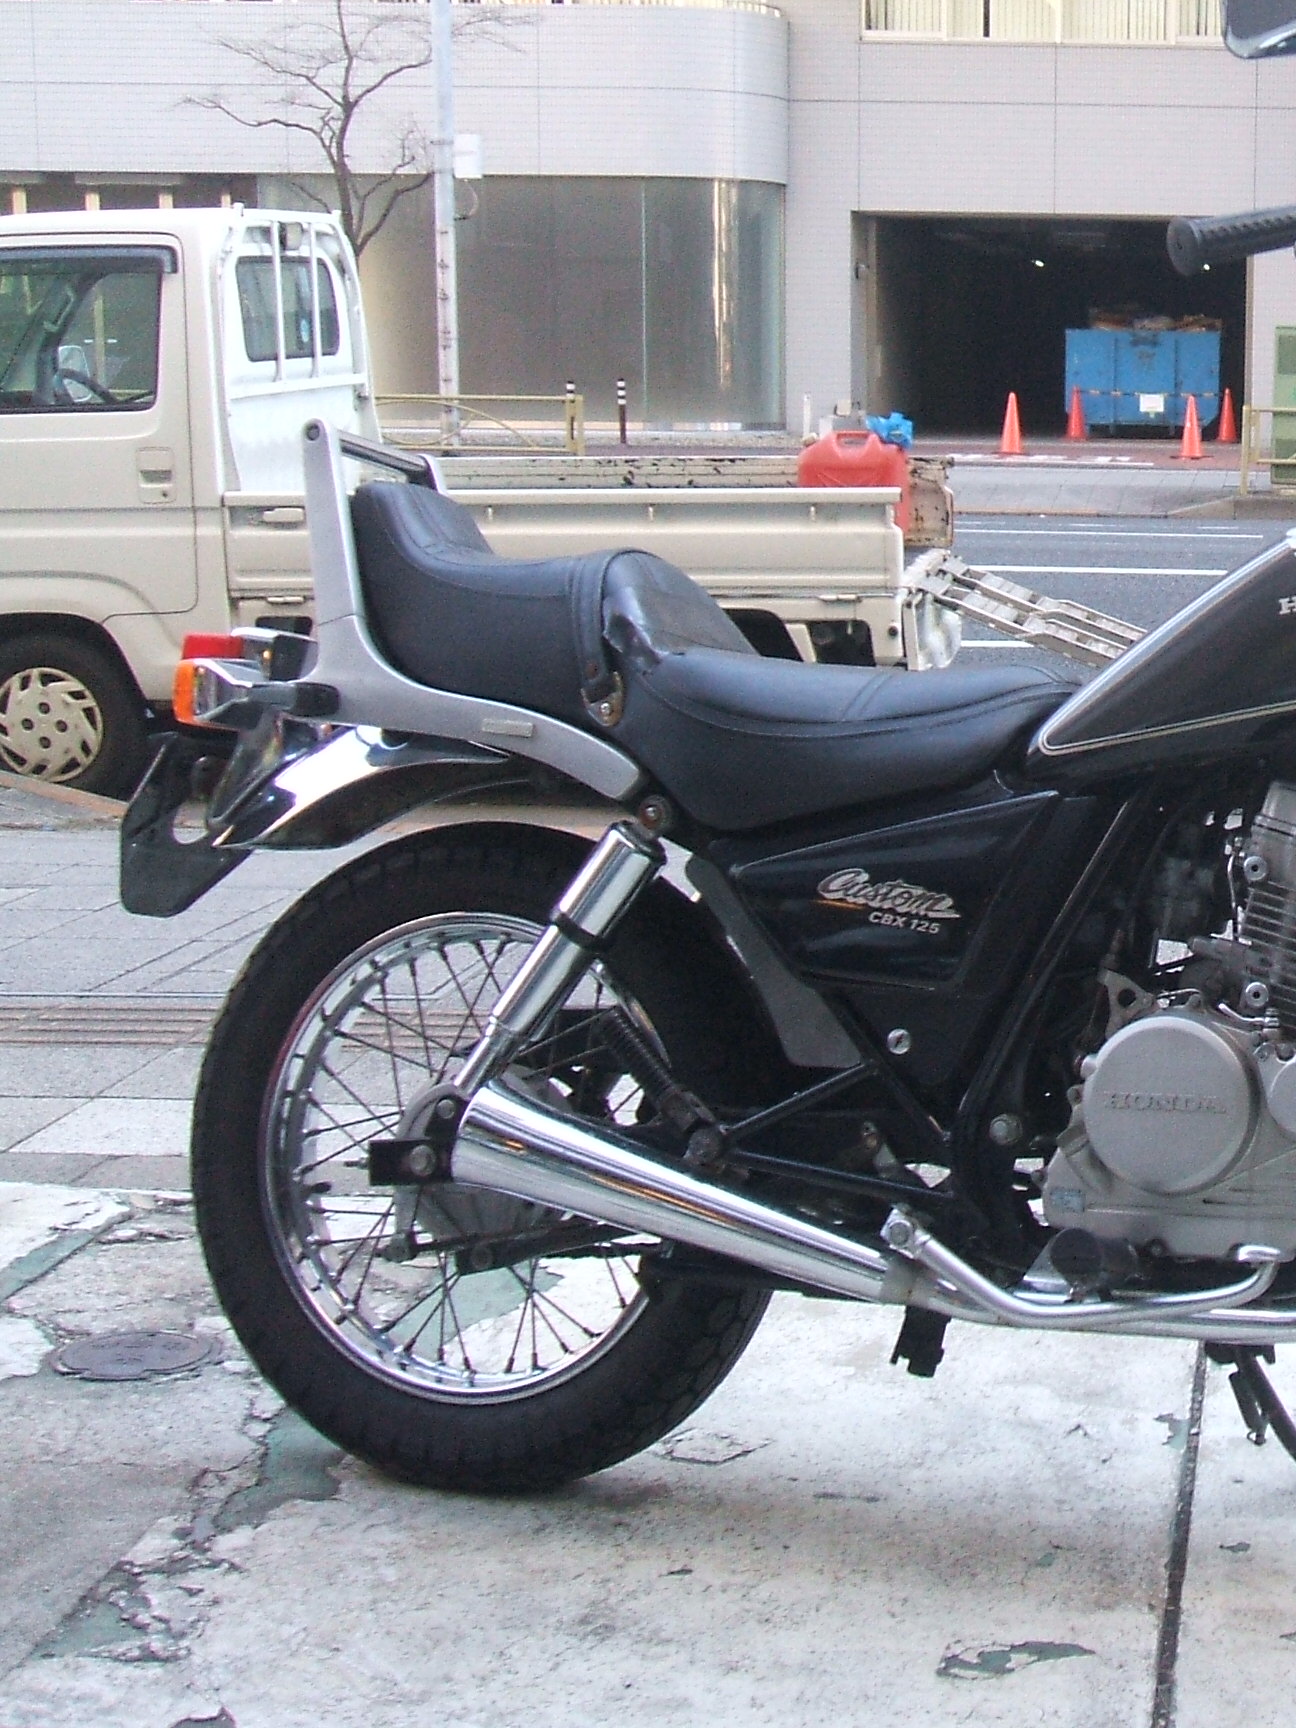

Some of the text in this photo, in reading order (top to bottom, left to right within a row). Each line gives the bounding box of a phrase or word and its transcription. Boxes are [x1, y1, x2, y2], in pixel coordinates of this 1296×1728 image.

[817, 867, 961, 918] Custom
[868, 911, 941, 935] CBX 125
[1103, 1091, 1227, 1115] HONDA
